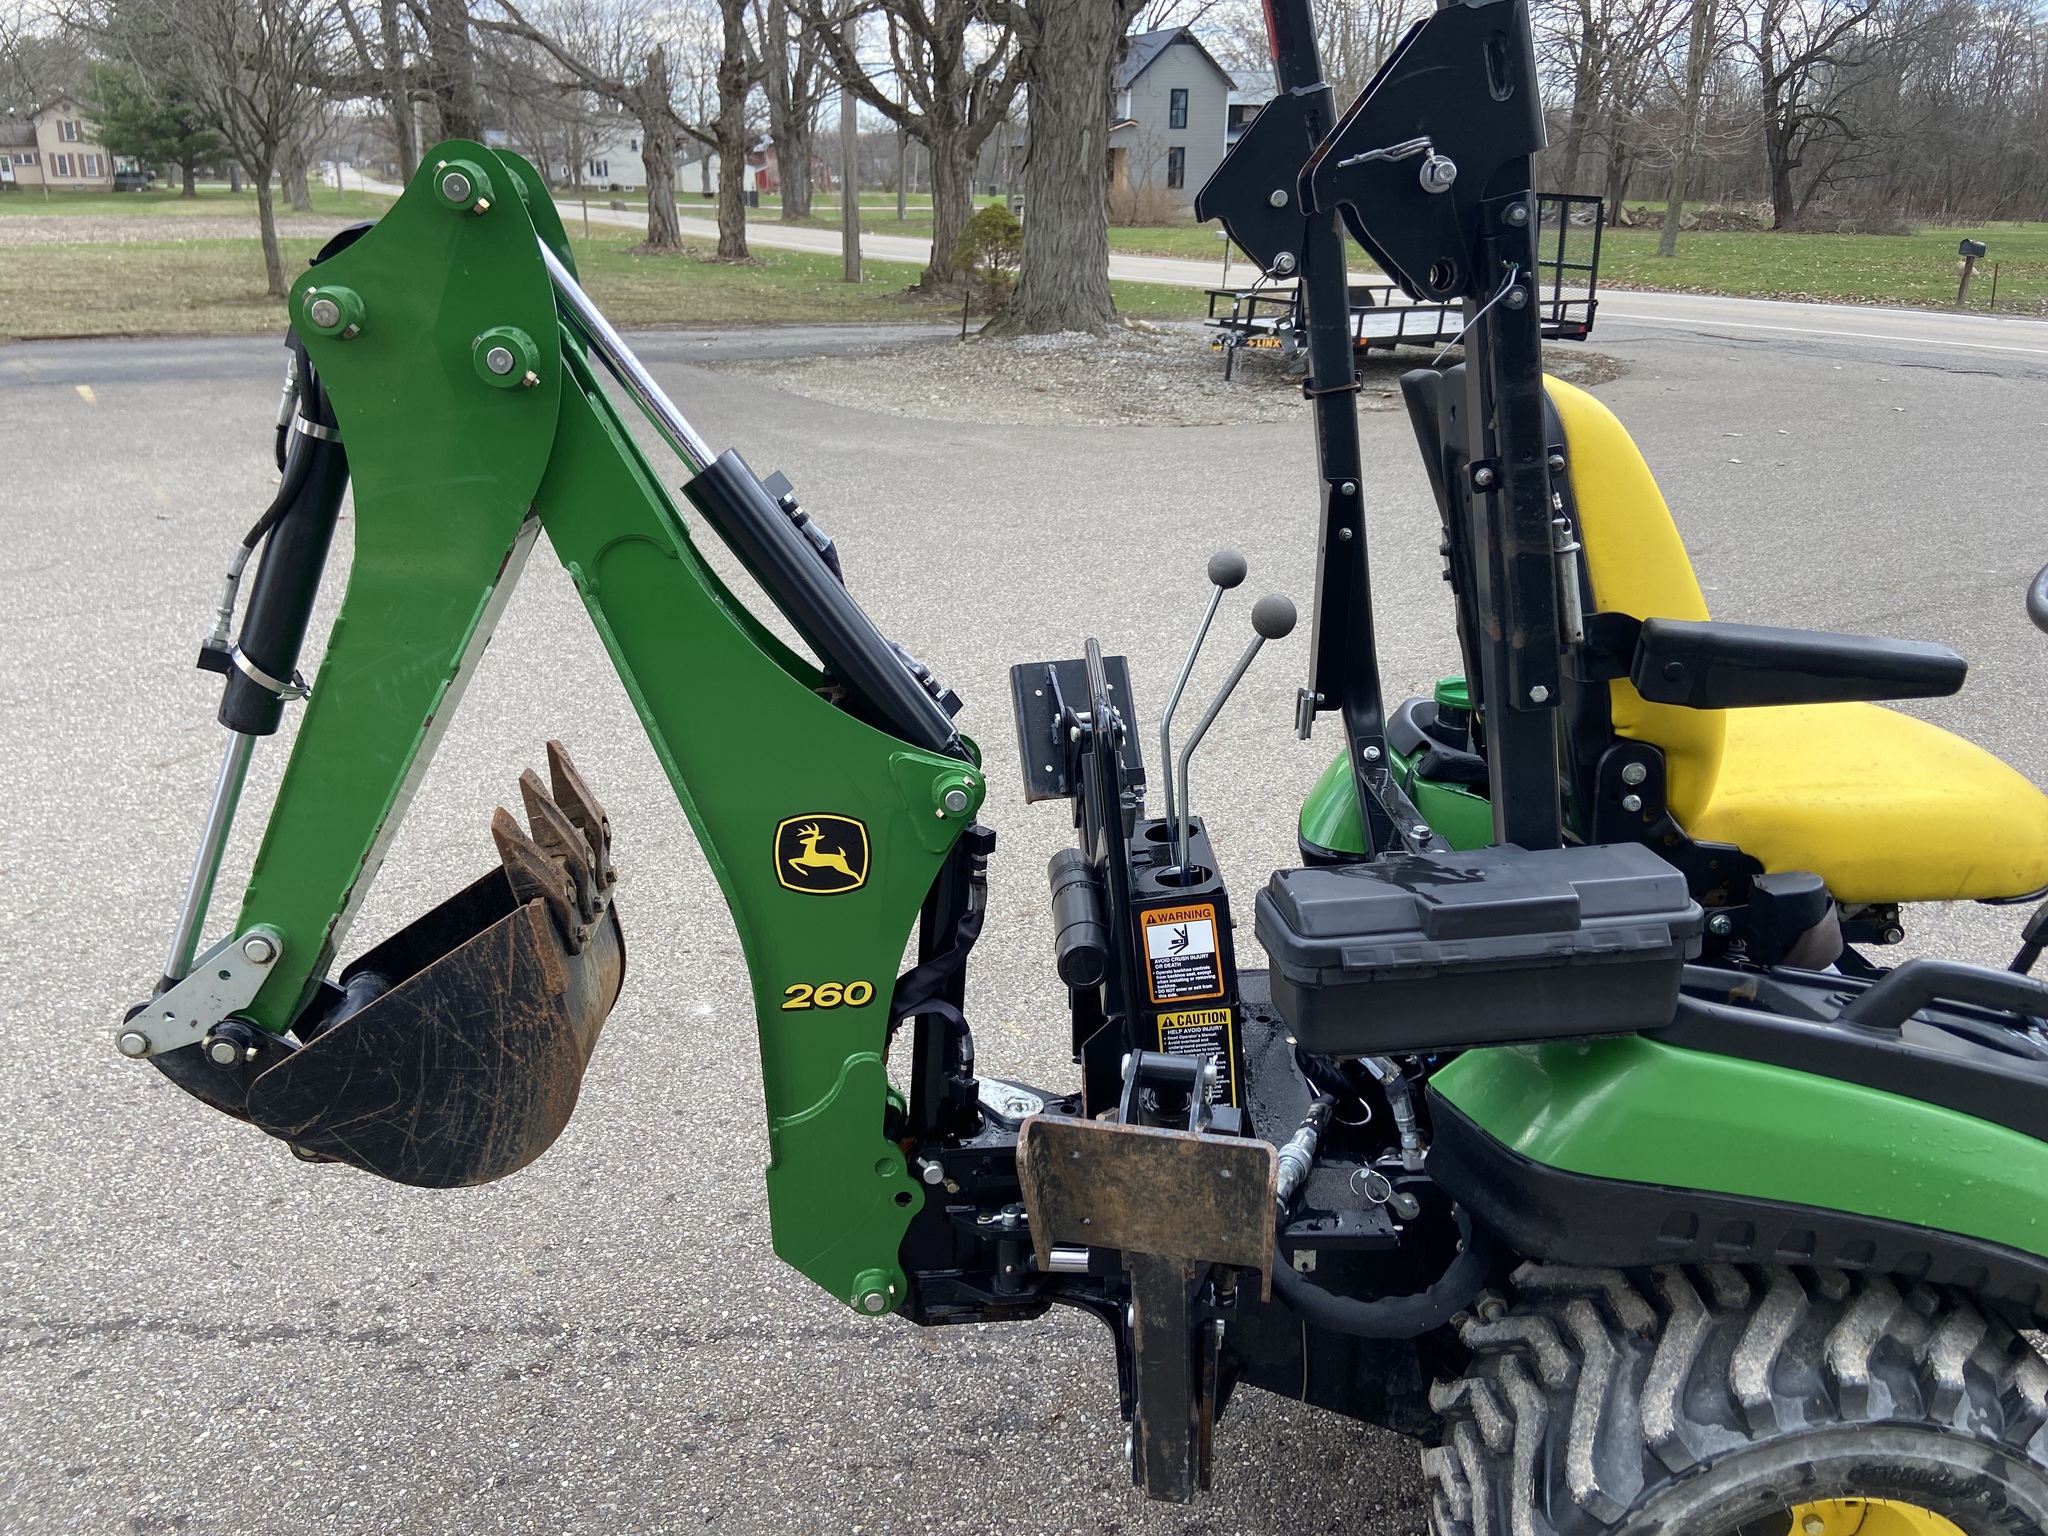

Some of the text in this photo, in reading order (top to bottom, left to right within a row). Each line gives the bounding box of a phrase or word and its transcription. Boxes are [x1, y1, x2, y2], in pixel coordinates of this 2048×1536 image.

[1256, 339, 1280, 348] LINX
[1158, 909, 1211, 922] WARNING
[781, 980, 876, 1012] 260
[1177, 1011, 1226, 1026] CAUTION
